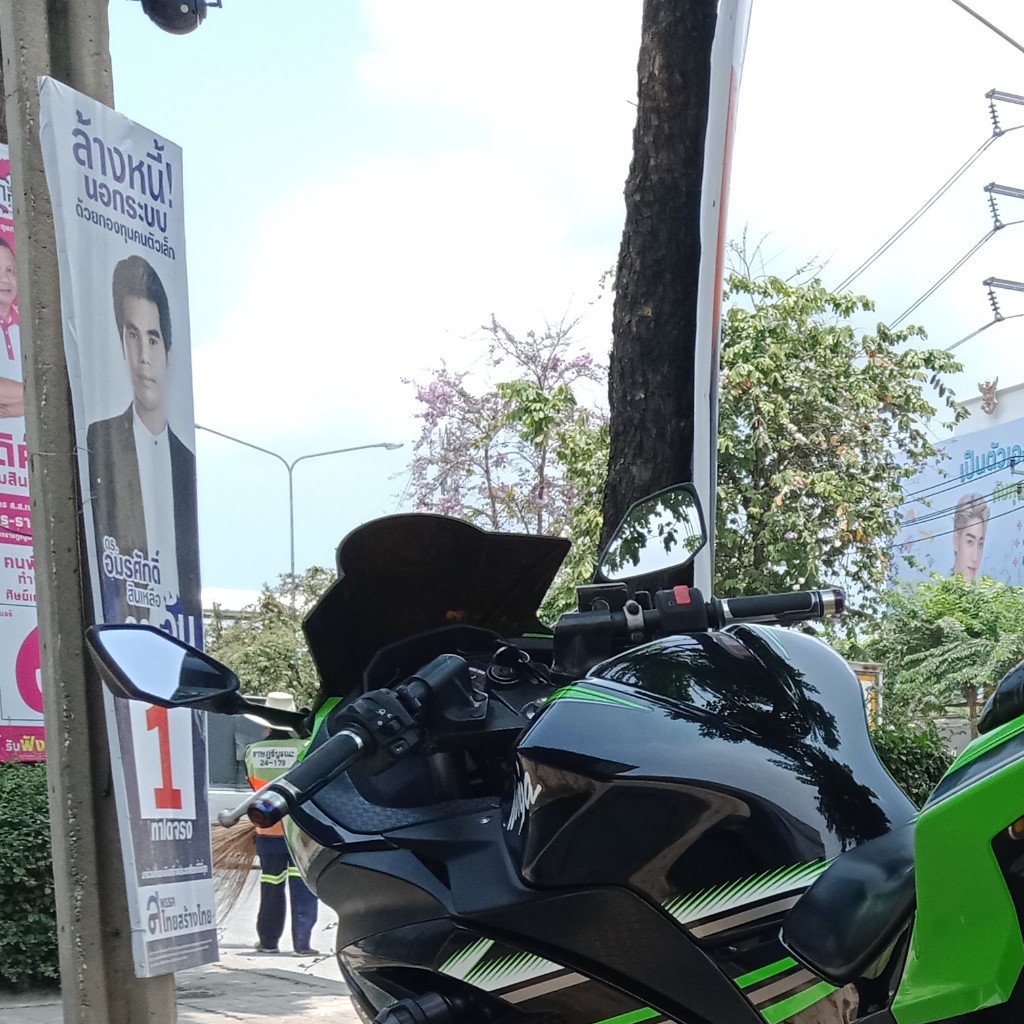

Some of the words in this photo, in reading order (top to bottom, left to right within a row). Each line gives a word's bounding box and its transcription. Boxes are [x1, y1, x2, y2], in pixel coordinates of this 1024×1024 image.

[72, 109, 173, 208] ล้างหนี้!
[75, 197, 176, 260] ด้วยกองทุนคนตัวเล็ก
[84, 174, 167, 233] นอกระบบ
[145, 704, 182, 809] 1
